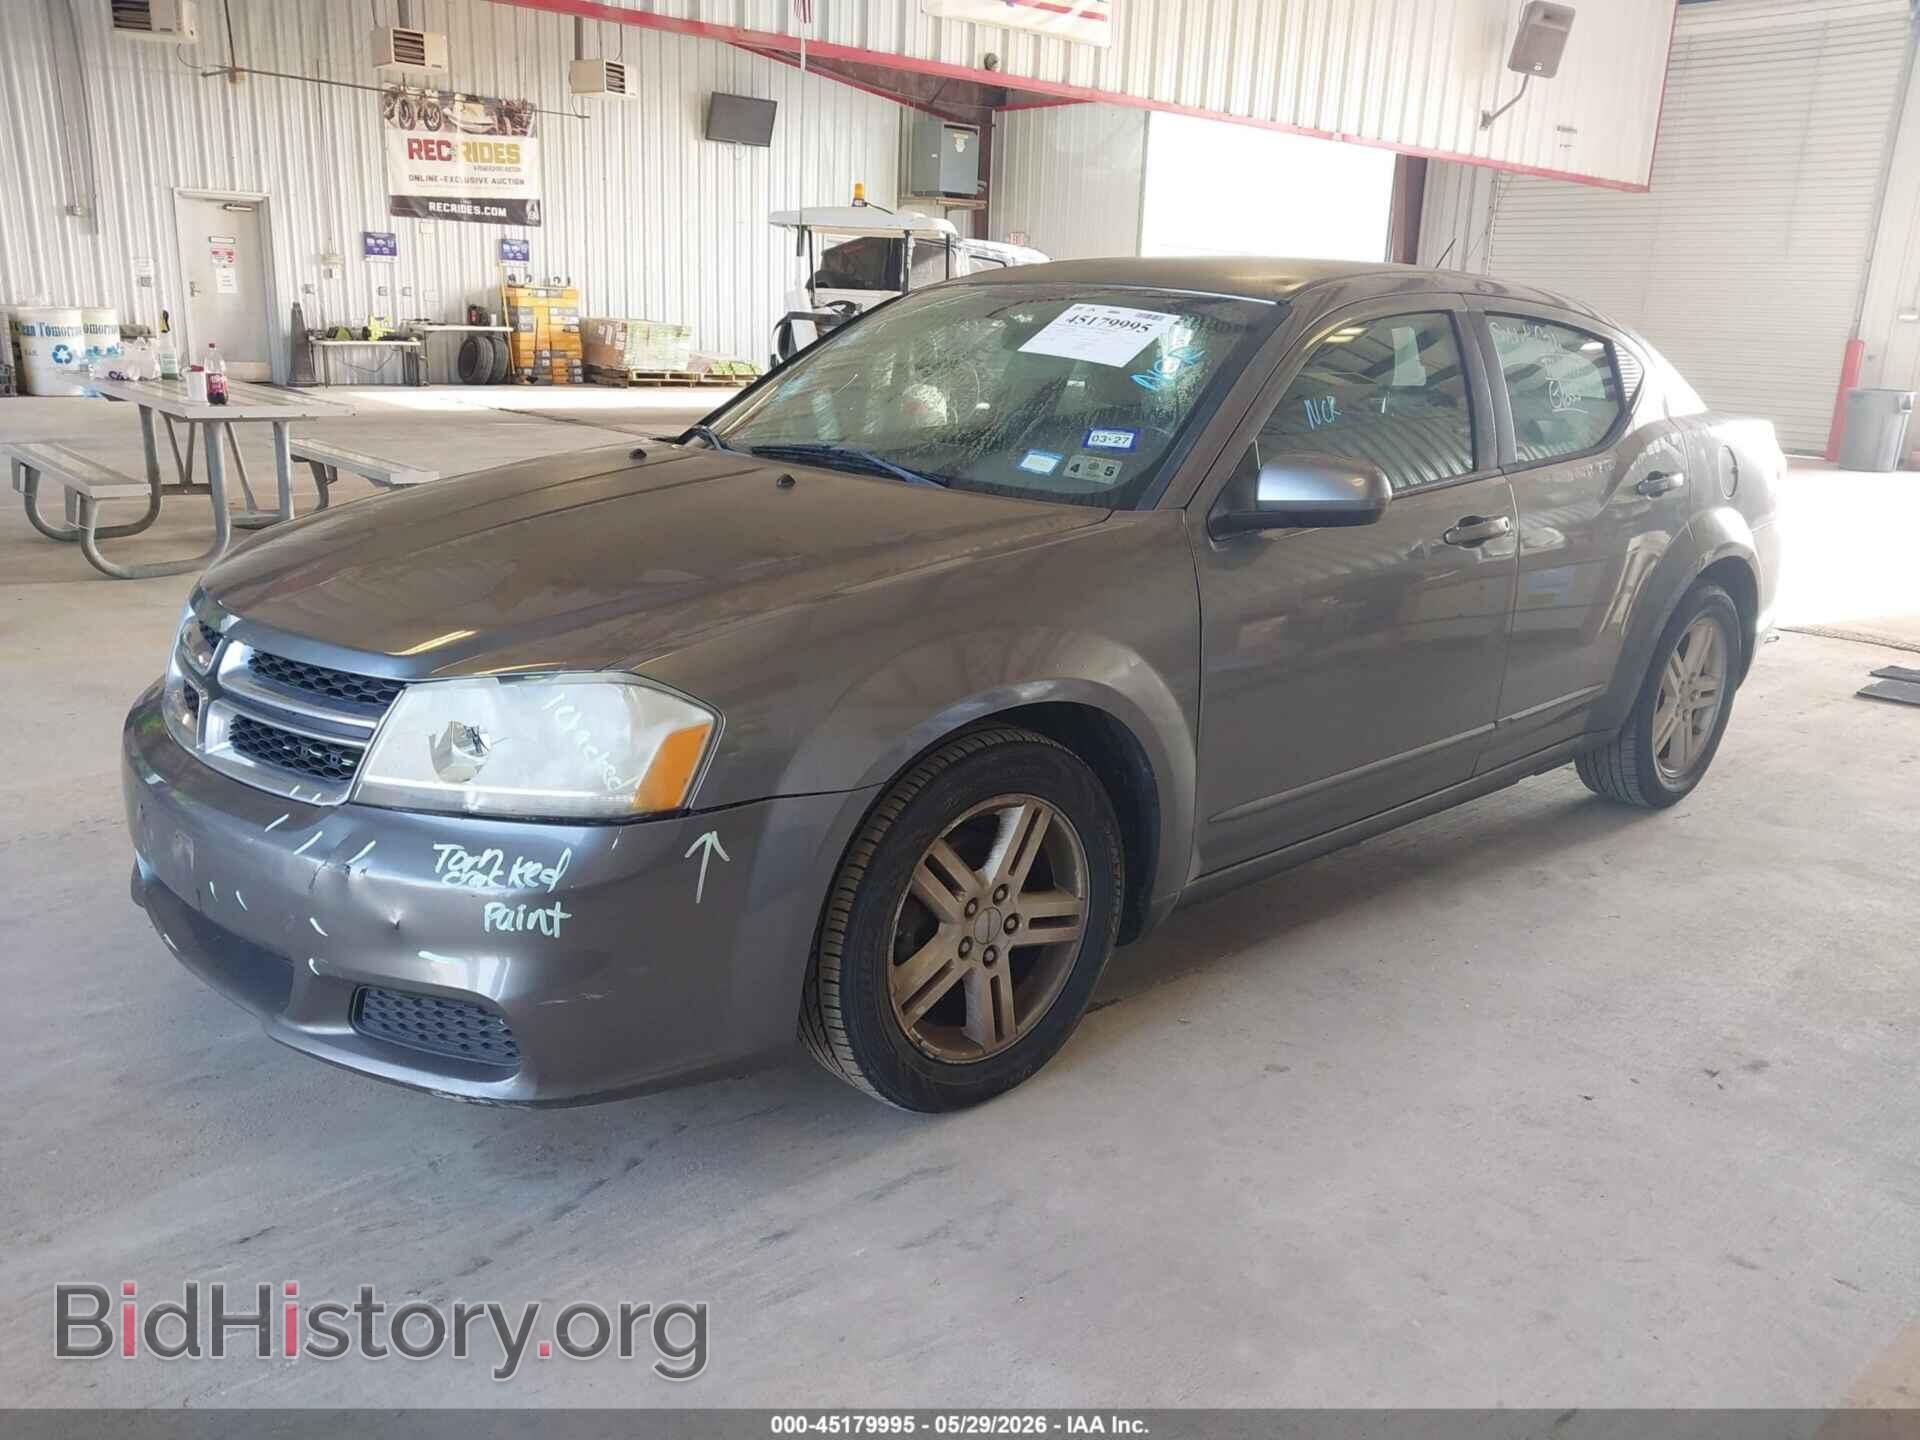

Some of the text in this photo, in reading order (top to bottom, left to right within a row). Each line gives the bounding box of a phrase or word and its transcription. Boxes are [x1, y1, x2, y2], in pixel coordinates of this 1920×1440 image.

[407, 138, 521, 164] REC RIDES
[408, 174, 489, 185] ONLINE-EXCUSIVE
[491, 177, 525, 186] AUCTION
[429, 201, 507, 217] RECRIDES.COM
[1065, 313, 1153, 334] 45179995
[1070, 463, 1116, 477] 4 5
